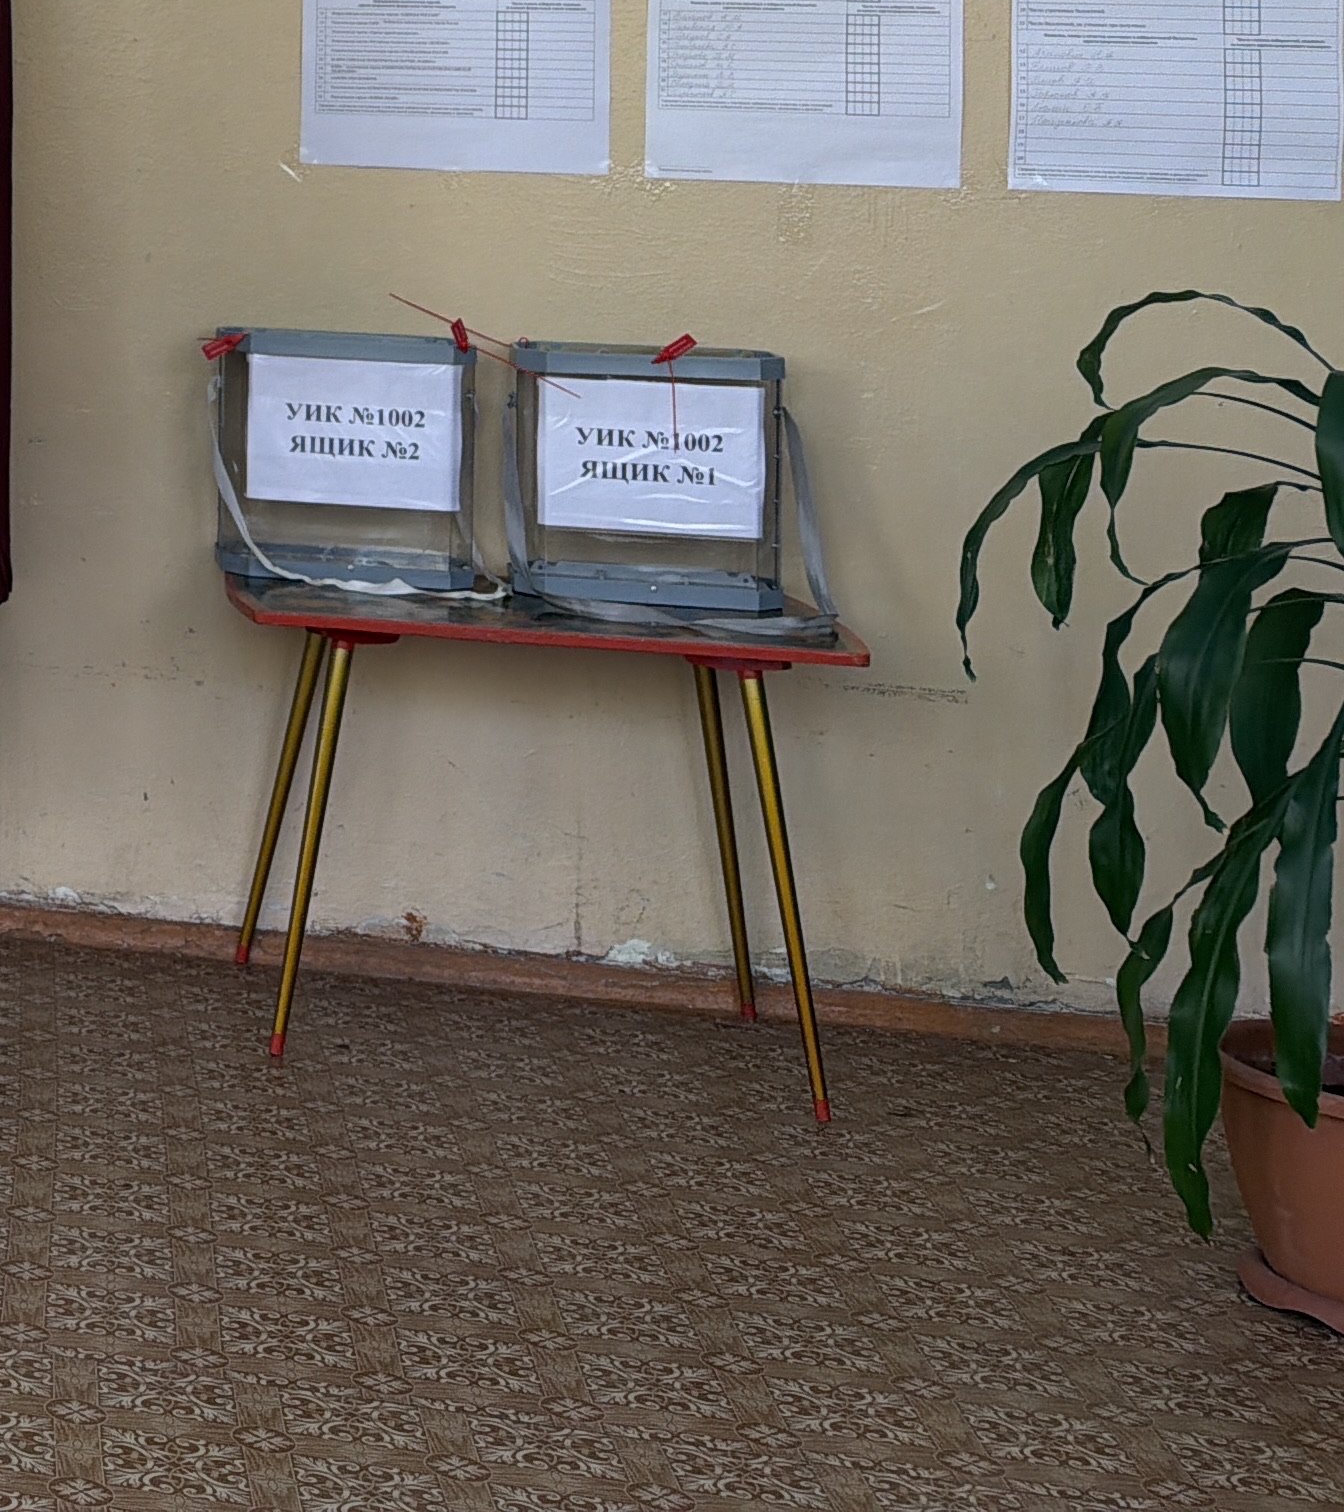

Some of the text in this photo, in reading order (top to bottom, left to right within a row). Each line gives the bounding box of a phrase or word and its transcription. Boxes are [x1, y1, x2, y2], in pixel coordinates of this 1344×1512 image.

[285, 402, 426, 428] УИК №1002
[289, 434, 420, 460] ЯЩИК №2
[575, 426, 724, 453] УИК №1002
[580, 459, 716, 486] ЯЩИК №1
